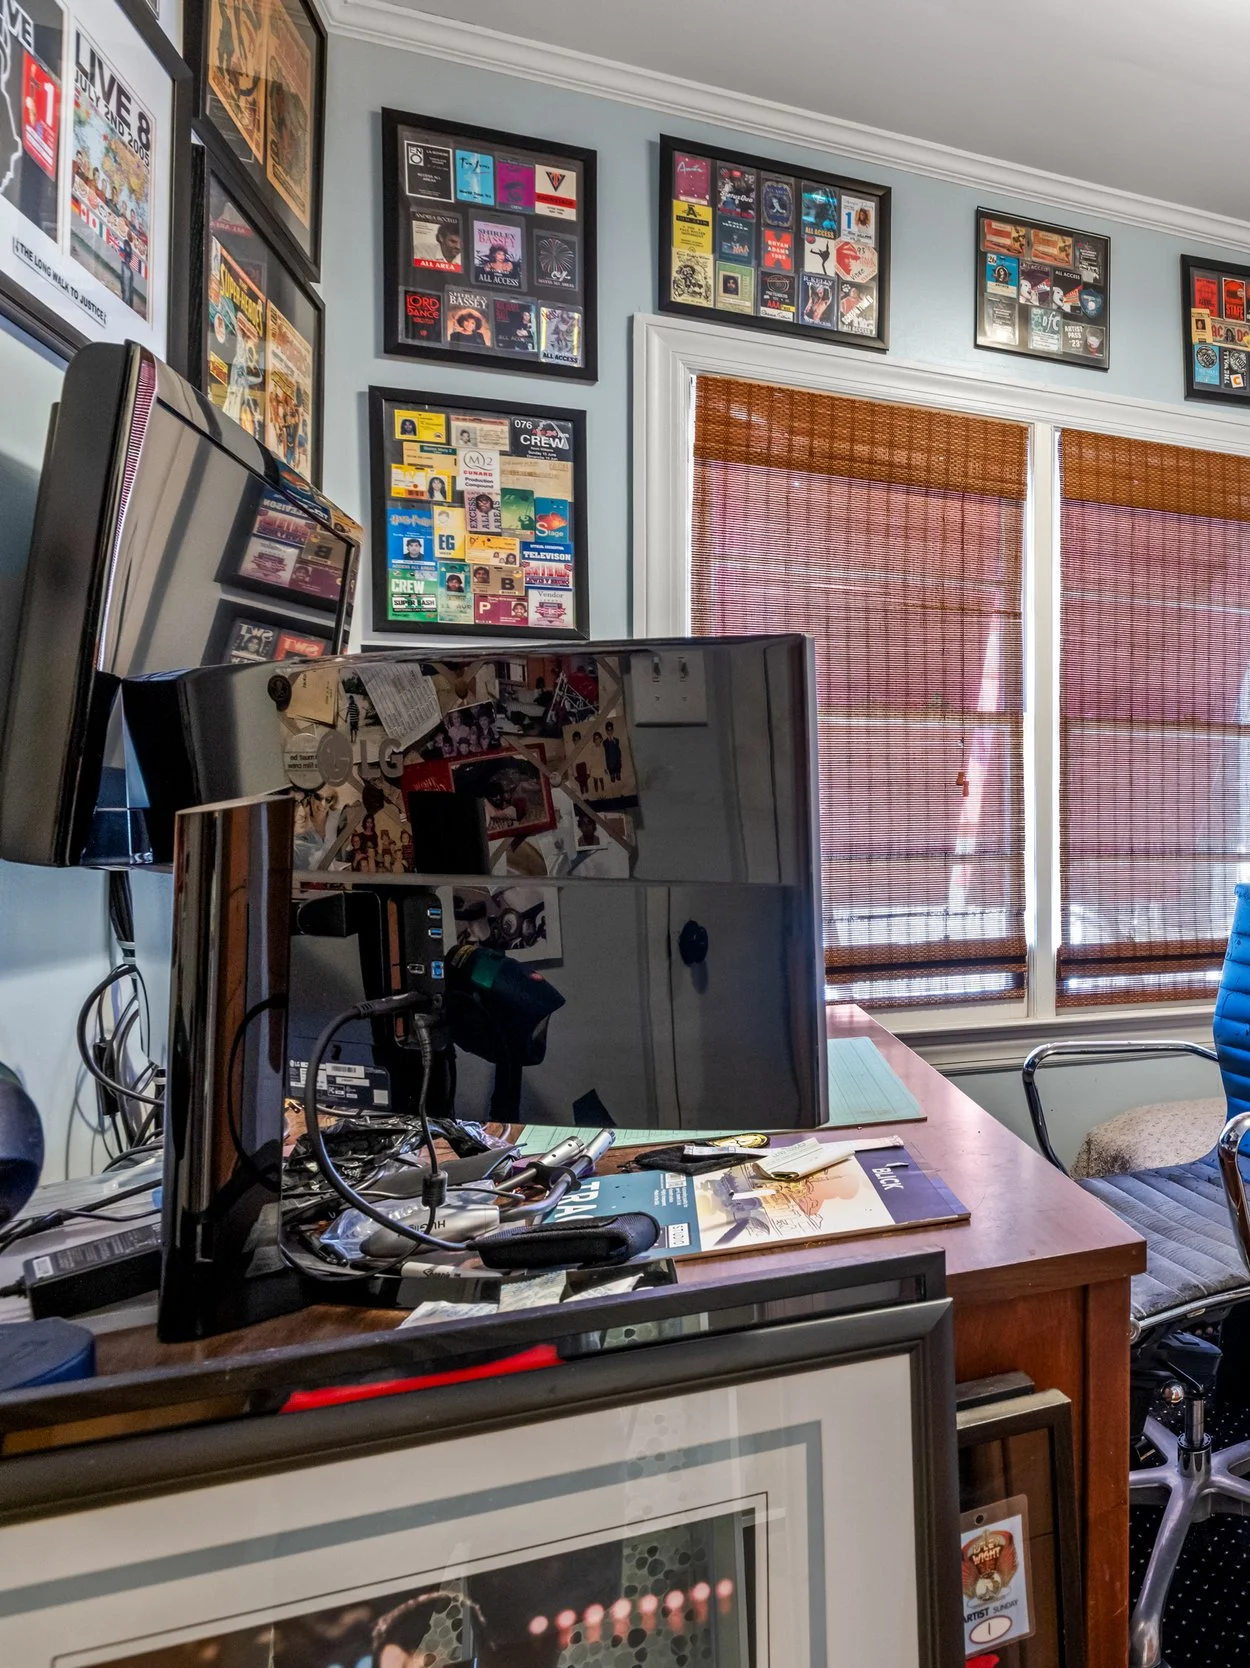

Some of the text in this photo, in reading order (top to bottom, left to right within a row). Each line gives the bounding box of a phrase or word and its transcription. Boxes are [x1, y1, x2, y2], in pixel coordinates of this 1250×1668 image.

[76, 29, 150, 152] LIVE 8
[44, 82, 54, 127] 1
[75, 69, 149, 167] JULY 2ND 2005
[478, 228, 516, 239] SHIRLEY
[478, 233, 515, 248] BASSEY
[814, 229, 834, 238] ACCESS
[768, 240, 789, 248] BRYAN
[768, 246, 789, 254] ADAMS
[420, 260, 434, 268] ALL
[19, 243, 104, 320] THE LONG WALK TO JUSTICE
[479, 273, 519, 287] ALL ACCESS
[1063, 272, 1081, 280] ACCESS
[406, 295, 439, 311] LORD
[449, 294, 488, 309] BASSEY
[407, 307, 439, 319] DANCE
[1226, 305, 1244, 319] STAFF
[555, 355, 578, 363] ACCESS
[514, 420, 532, 429] 076
[520, 435, 564, 448] CREW
[469, 497, 478, 529] EXCESS
[536, 521, 564, 537] Stage
[438, 534, 455, 551] EG
[523, 551, 571, 560] TELEVISON
[391, 579, 425, 593] CREW
[501, 578, 515, 590] B
[479, 602, 491, 614] P
[360, 739, 404, 778] LG
[872, 1168, 903, 1191] BLICK
[972, 1546, 1001, 1564] WIGHT
[992, 1599, 1018, 1614] SUNDAY
